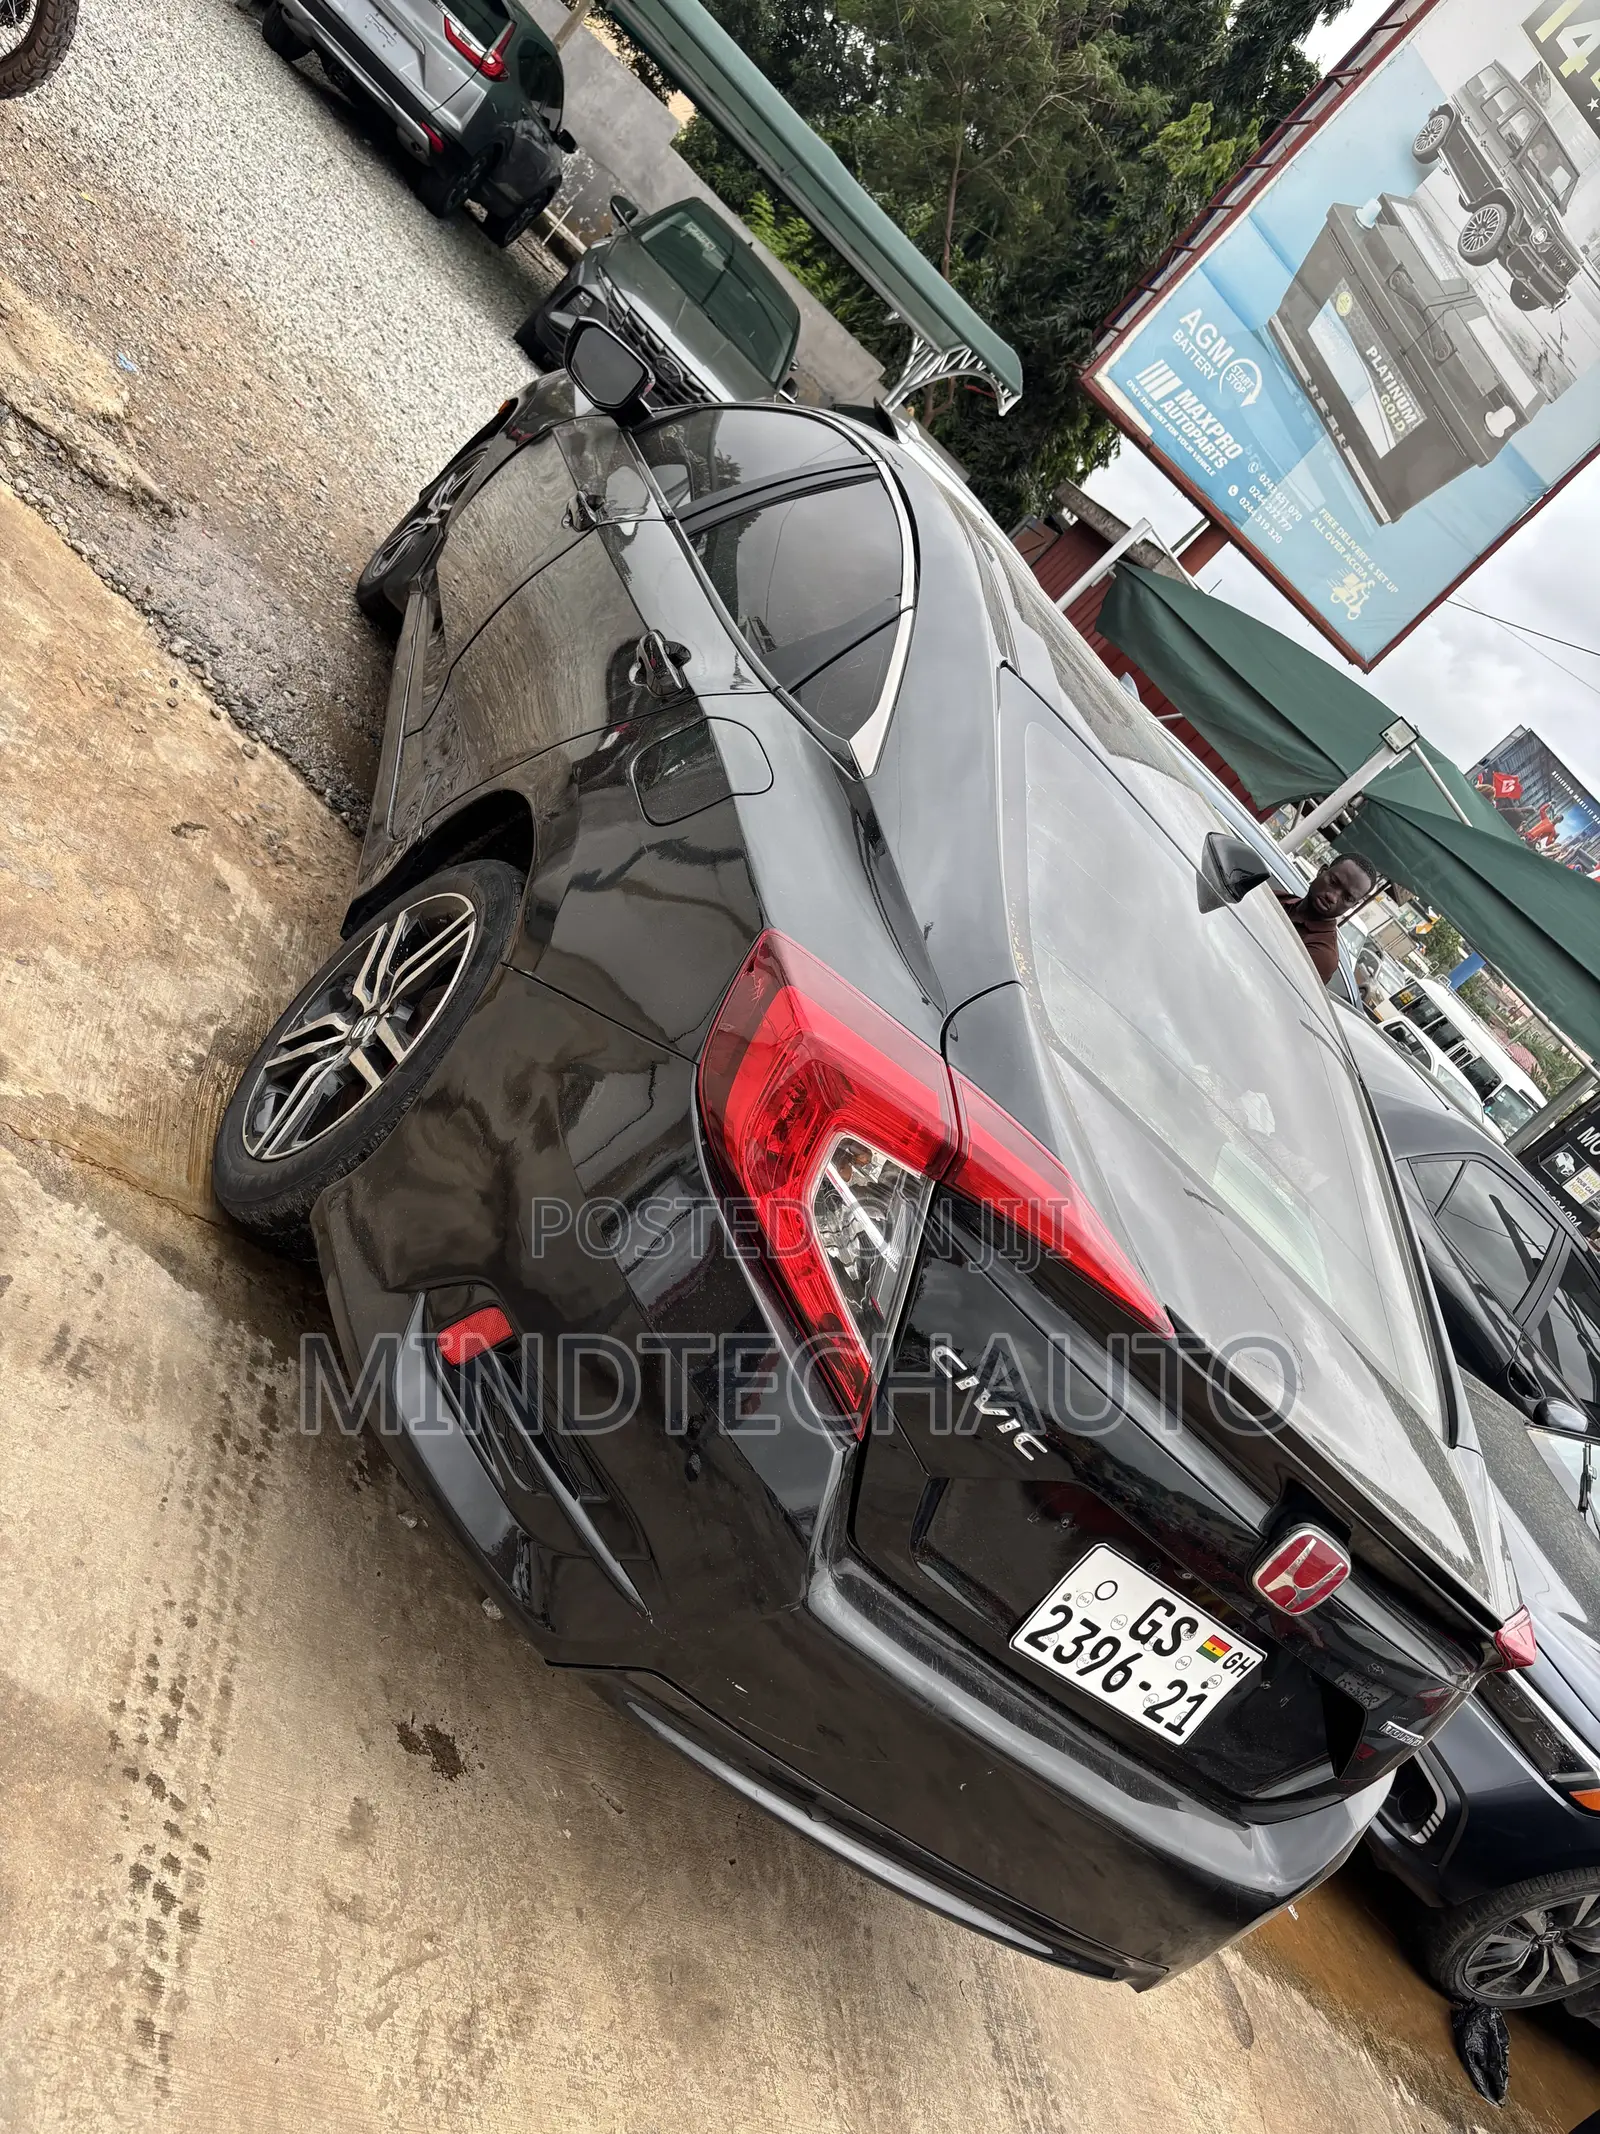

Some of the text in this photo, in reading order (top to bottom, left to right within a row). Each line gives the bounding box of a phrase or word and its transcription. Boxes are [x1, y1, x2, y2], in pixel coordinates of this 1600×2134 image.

[1172, 328, 1219, 380] BATTERY
[1179, 307, 1235, 368] AGM
[1226, 373, 1248, 394] STOP
[1231, 365, 1256, 389] START
[1365, 344, 1417, 424] PLATINUM
[1126, 380, 1216, 477] ONLY THE BEST FOR YOUR VEHICLE
[1160, 400, 1228, 469] AUTOPARTS
[1174, 388, 1243, 459] MAXPRO
[1380, 394, 1406, 432] GOLD
[1239, 497, 1258, 517] 0244
[1255, 514, 1269, 531] 319
[1267, 528, 1283, 544] 320
[1249, 485, 1268, 505] 0244
[1265, 502, 1279, 519] 272
[1277, 516, 1293, 532] 777
[1259, 474, 1302, 522] 0243 651 070
[1311, 517, 1368, 580] ALL OVER ACCRA
[1318, 507, 1340, 531] FREE
[1336, 527, 1371, 563] DELIVERY
[1373, 568, 1390, 586] SET
[1386, 579, 1399, 594] UP
[1570, 1181, 1588, 1200] HERE
[931, 1345, 1048, 1461] CIVIC
[1129, 1597, 1199, 1657] GS
[1024, 1604, 1208, 1737] 2396-21
[1222, 1651, 1256, 1678] GH
